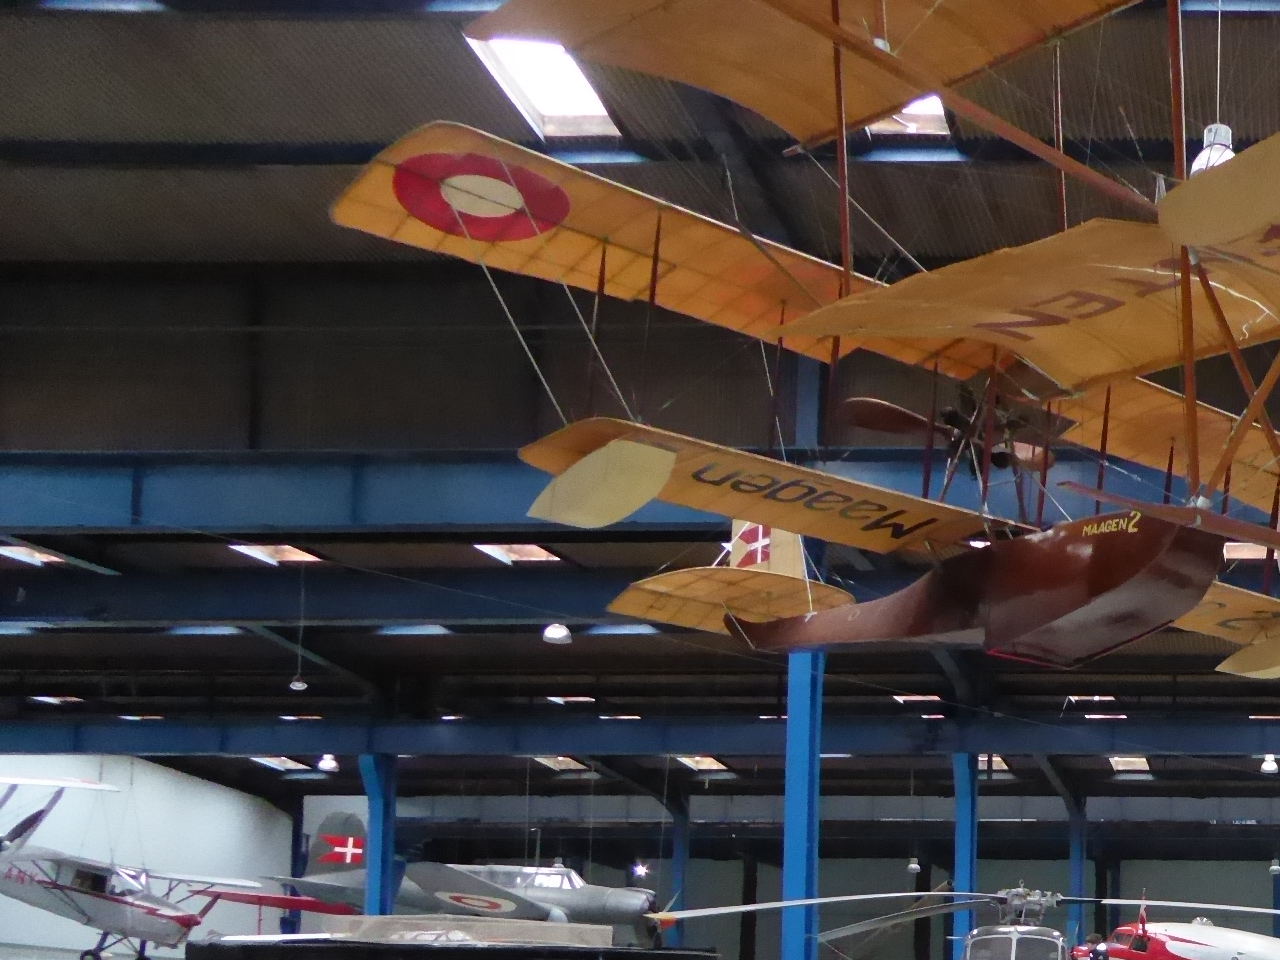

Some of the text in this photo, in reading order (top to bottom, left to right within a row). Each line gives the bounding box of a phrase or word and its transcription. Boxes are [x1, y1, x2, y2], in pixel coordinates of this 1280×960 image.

[691, 461, 939, 540] Maagen
[1082, 510, 1141, 537] MAAGEN 2
